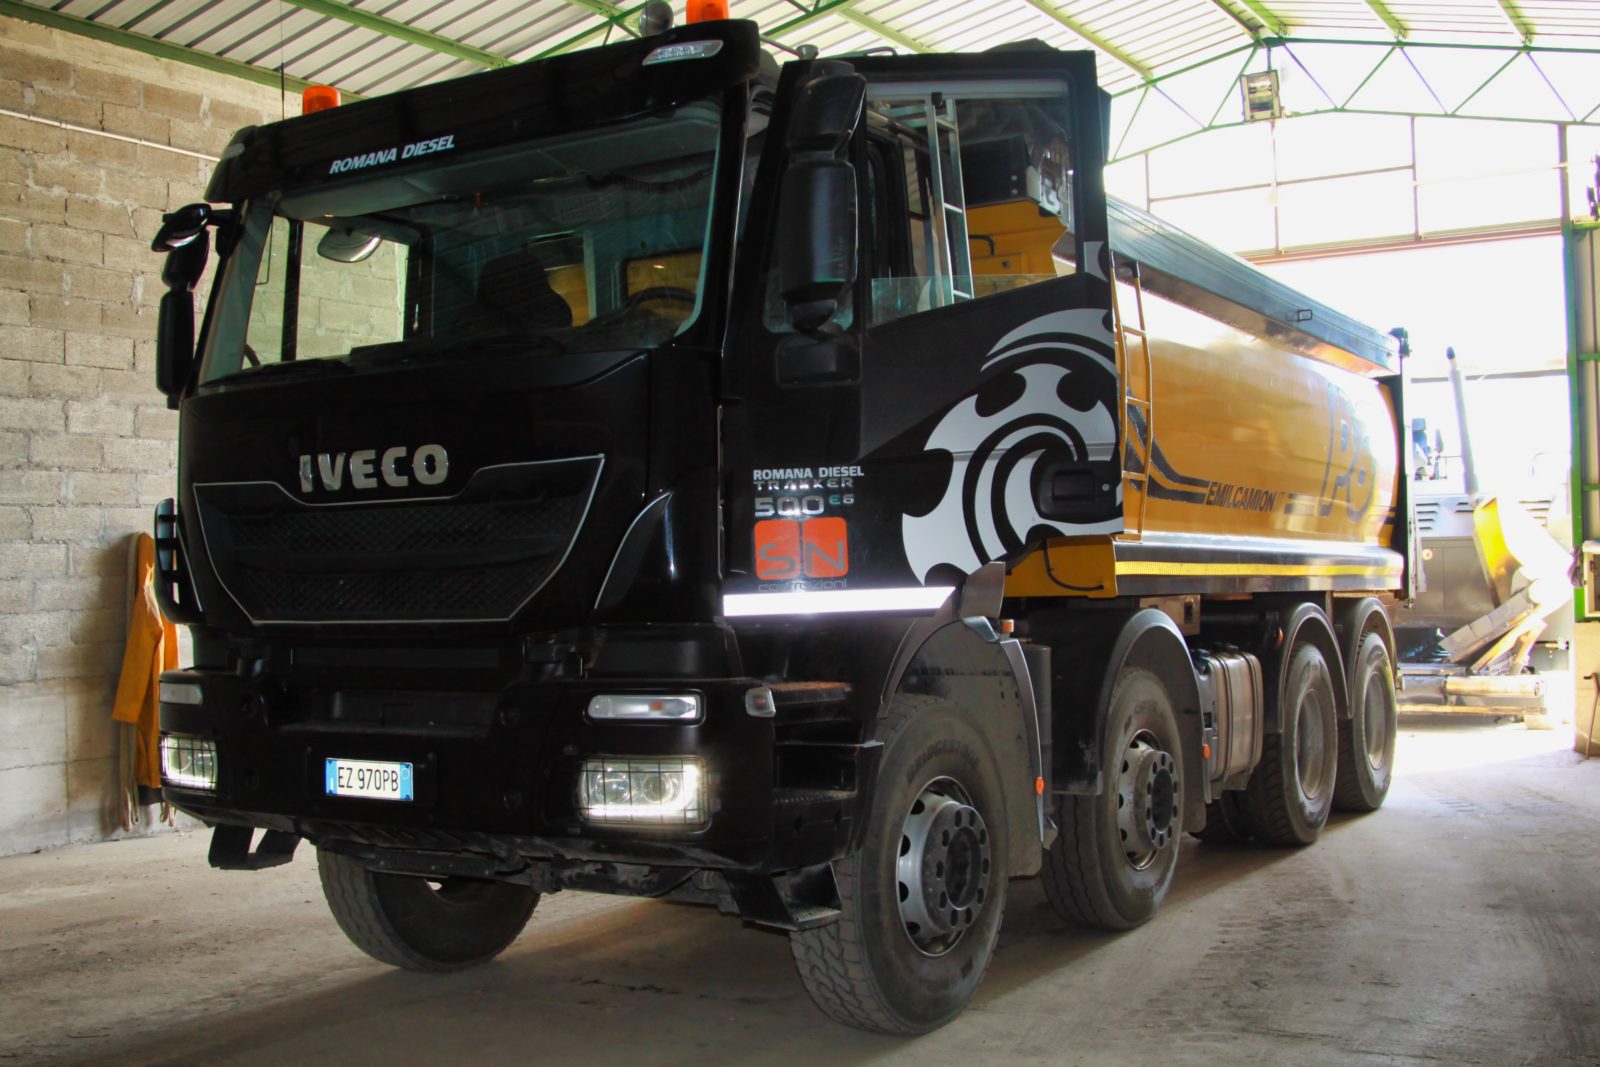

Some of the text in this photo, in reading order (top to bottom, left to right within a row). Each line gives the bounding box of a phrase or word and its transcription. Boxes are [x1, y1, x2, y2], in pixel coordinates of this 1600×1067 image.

[329, 135, 455, 174] ROMANA DIESEL
[299, 444, 449, 493] IVECO
[753, 466, 864, 480] ROMANA DIESEL
[753, 477, 854, 491] TRAKKER
[755, 493, 855, 517] 500 E6
[338, 766, 399, 792] EZ 970PB
